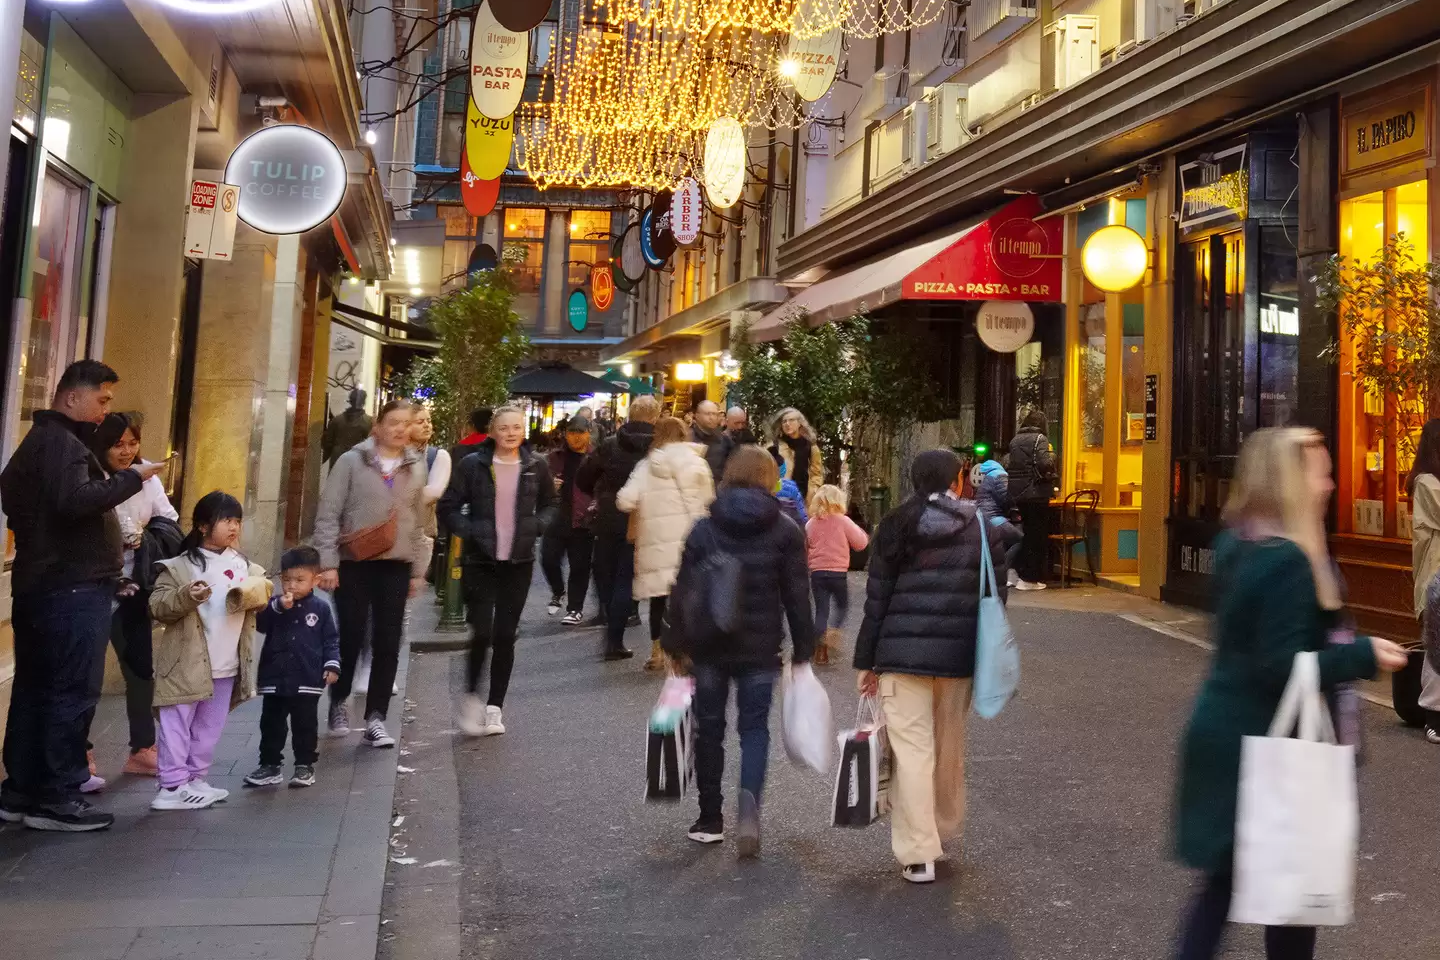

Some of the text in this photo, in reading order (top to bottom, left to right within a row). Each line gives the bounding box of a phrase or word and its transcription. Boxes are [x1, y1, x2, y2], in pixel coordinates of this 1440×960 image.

[487, 32, 516, 48] il tempo
[792, 51, 836, 65] PIZZA
[473, 65, 523, 79] PASTA
[484, 80, 510, 90] BAR
[470, 117, 510, 130] YUZU
[1357, 110, 1416, 155] IL PAPIRO
[250, 160, 326, 181] TULIP
[193, 183, 217, 196] LOADING
[245, 182, 326, 200] COFFEE
[193, 194, 214, 206] ZONE
[681, 179, 692, 231] BARBER
[999, 237, 1042, 258] il tempo
[914, 282, 1049, 295] PIZZA PASTA BAR
[994, 315, 1027, 334] tempo
